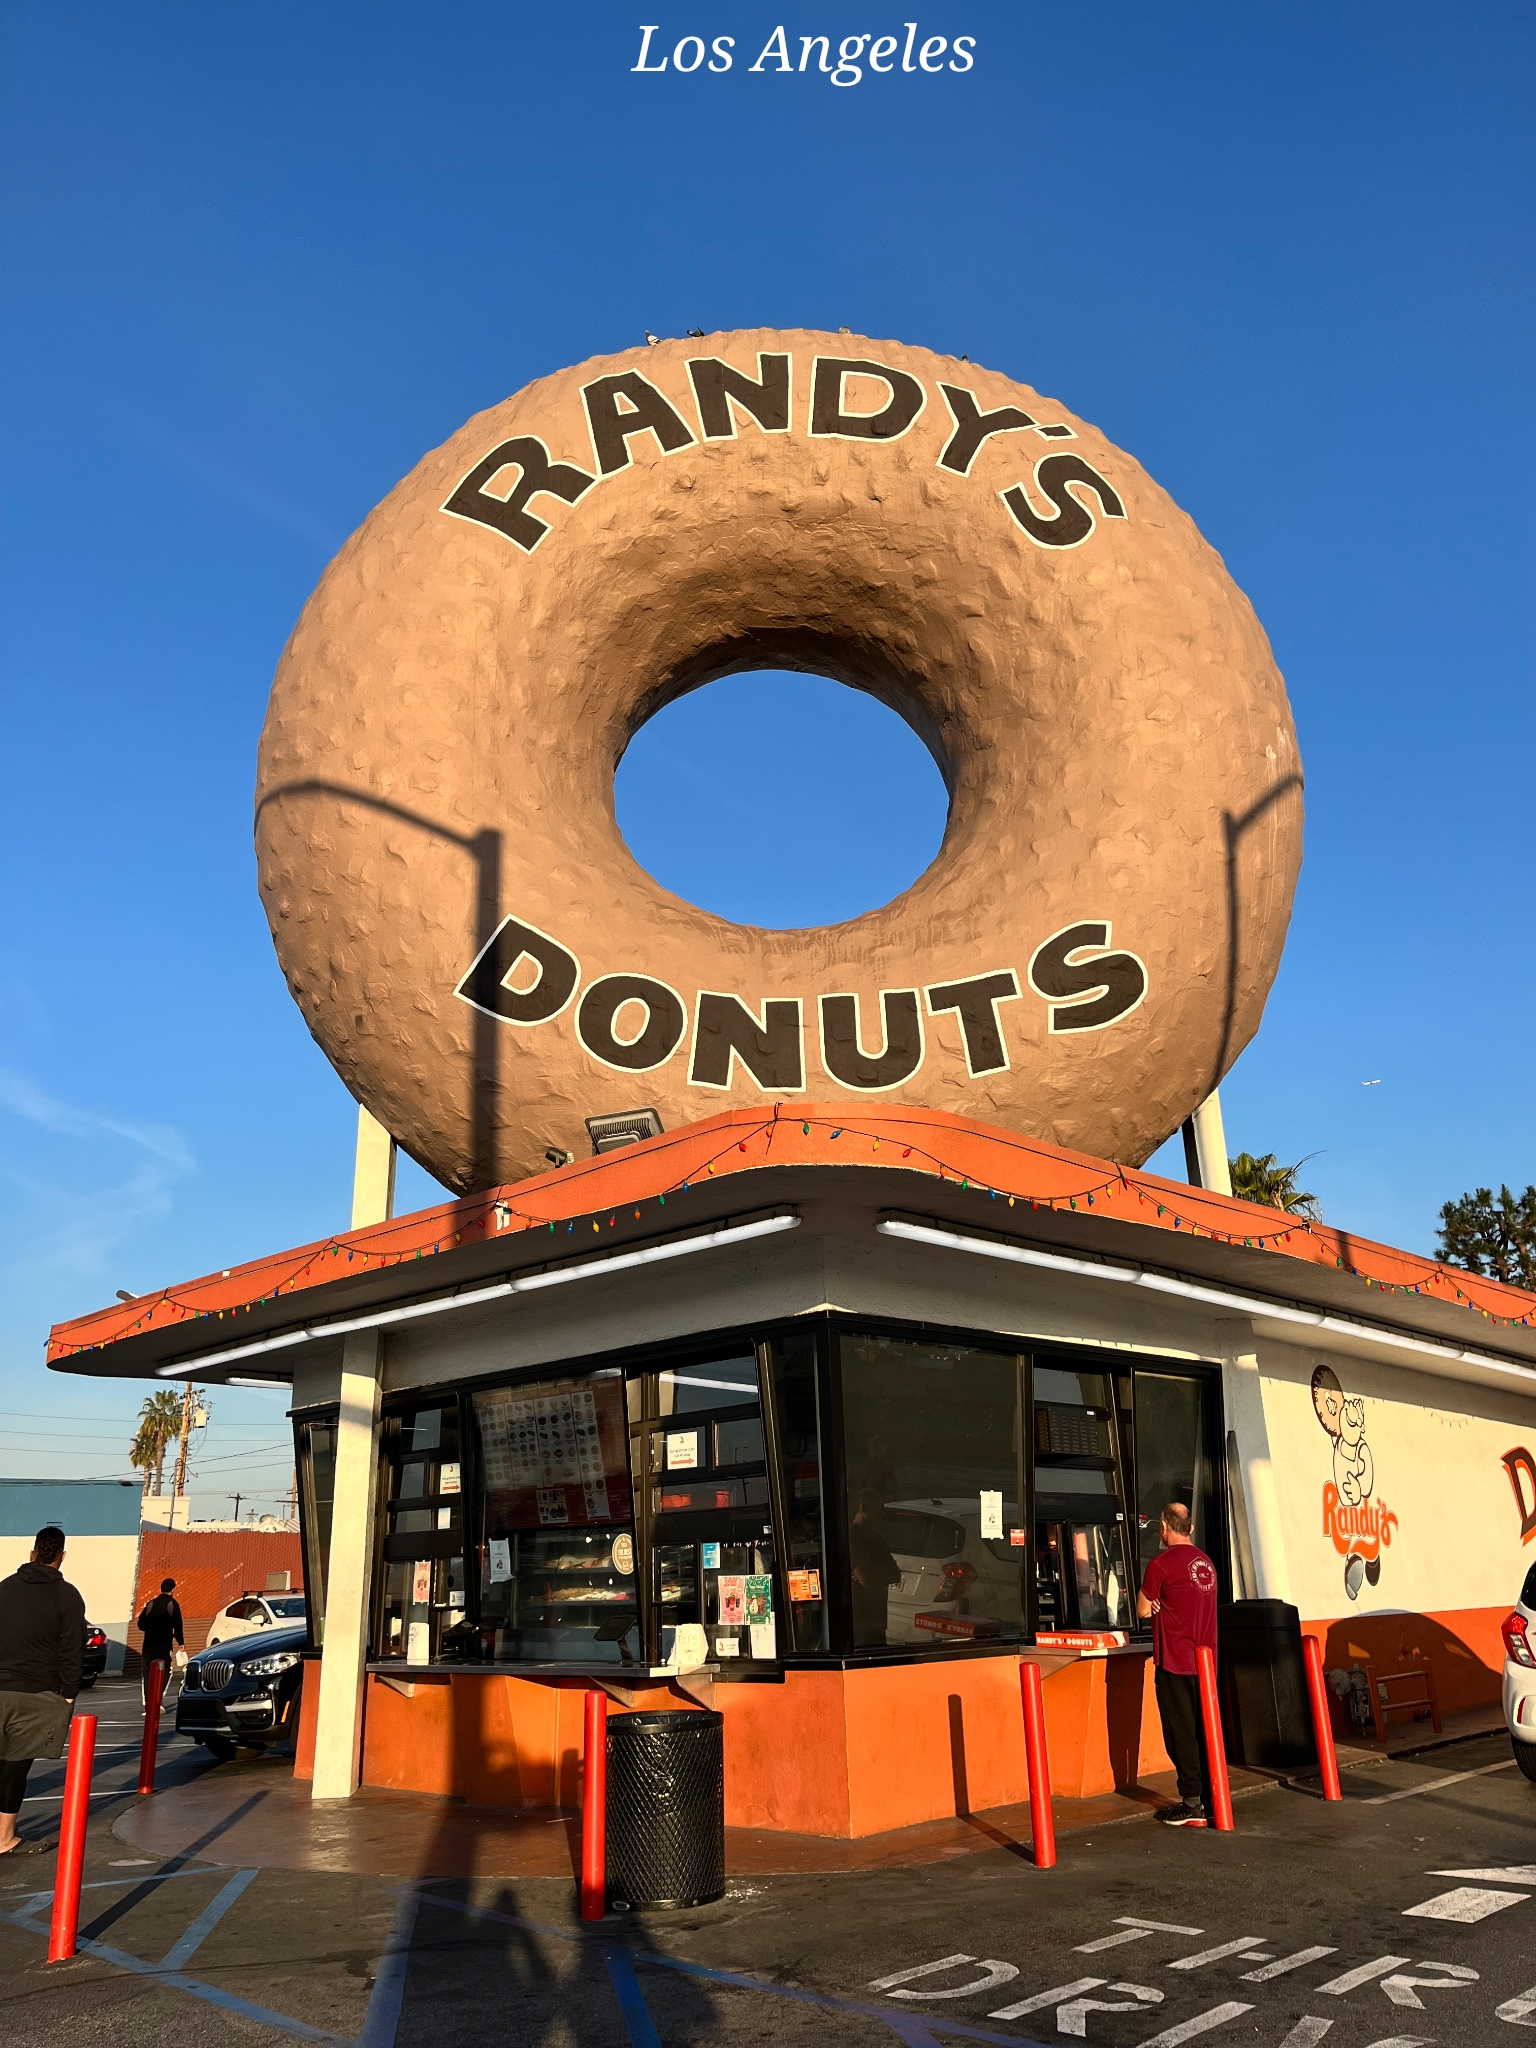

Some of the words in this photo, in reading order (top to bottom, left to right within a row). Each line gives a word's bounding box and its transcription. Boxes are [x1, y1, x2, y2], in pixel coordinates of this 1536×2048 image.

[439, 351, 1128, 555] RANDY'S
[452, 913, 1148, 1093] DONUTS
[1322, 1480, 1399, 1562] Randy's
[1037, 1636, 1062, 1645] RANDY'S
[1067, 1638, 1093, 1646] DONUTS
